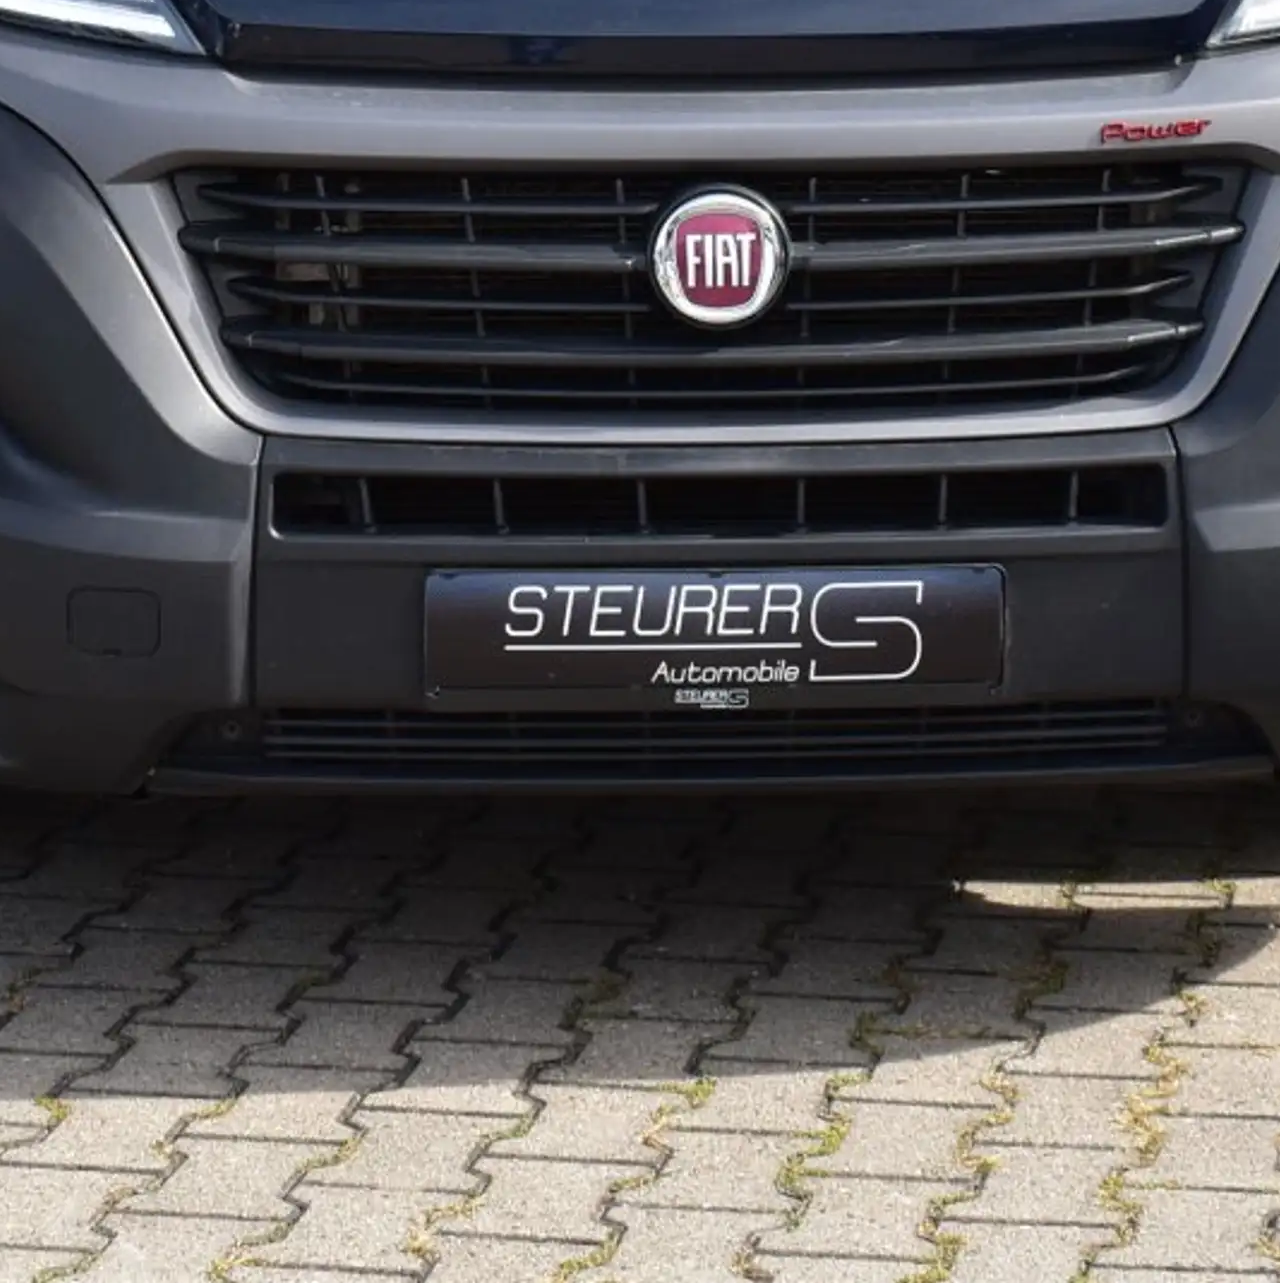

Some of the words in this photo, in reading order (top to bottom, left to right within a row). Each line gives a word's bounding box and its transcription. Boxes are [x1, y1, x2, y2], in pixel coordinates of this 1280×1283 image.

[1100, 118, 1212, 145] Power
[685, 232, 757, 288] FIAT
[505, 584, 803, 637] STEURER
[650, 659, 800, 684] Automobile
